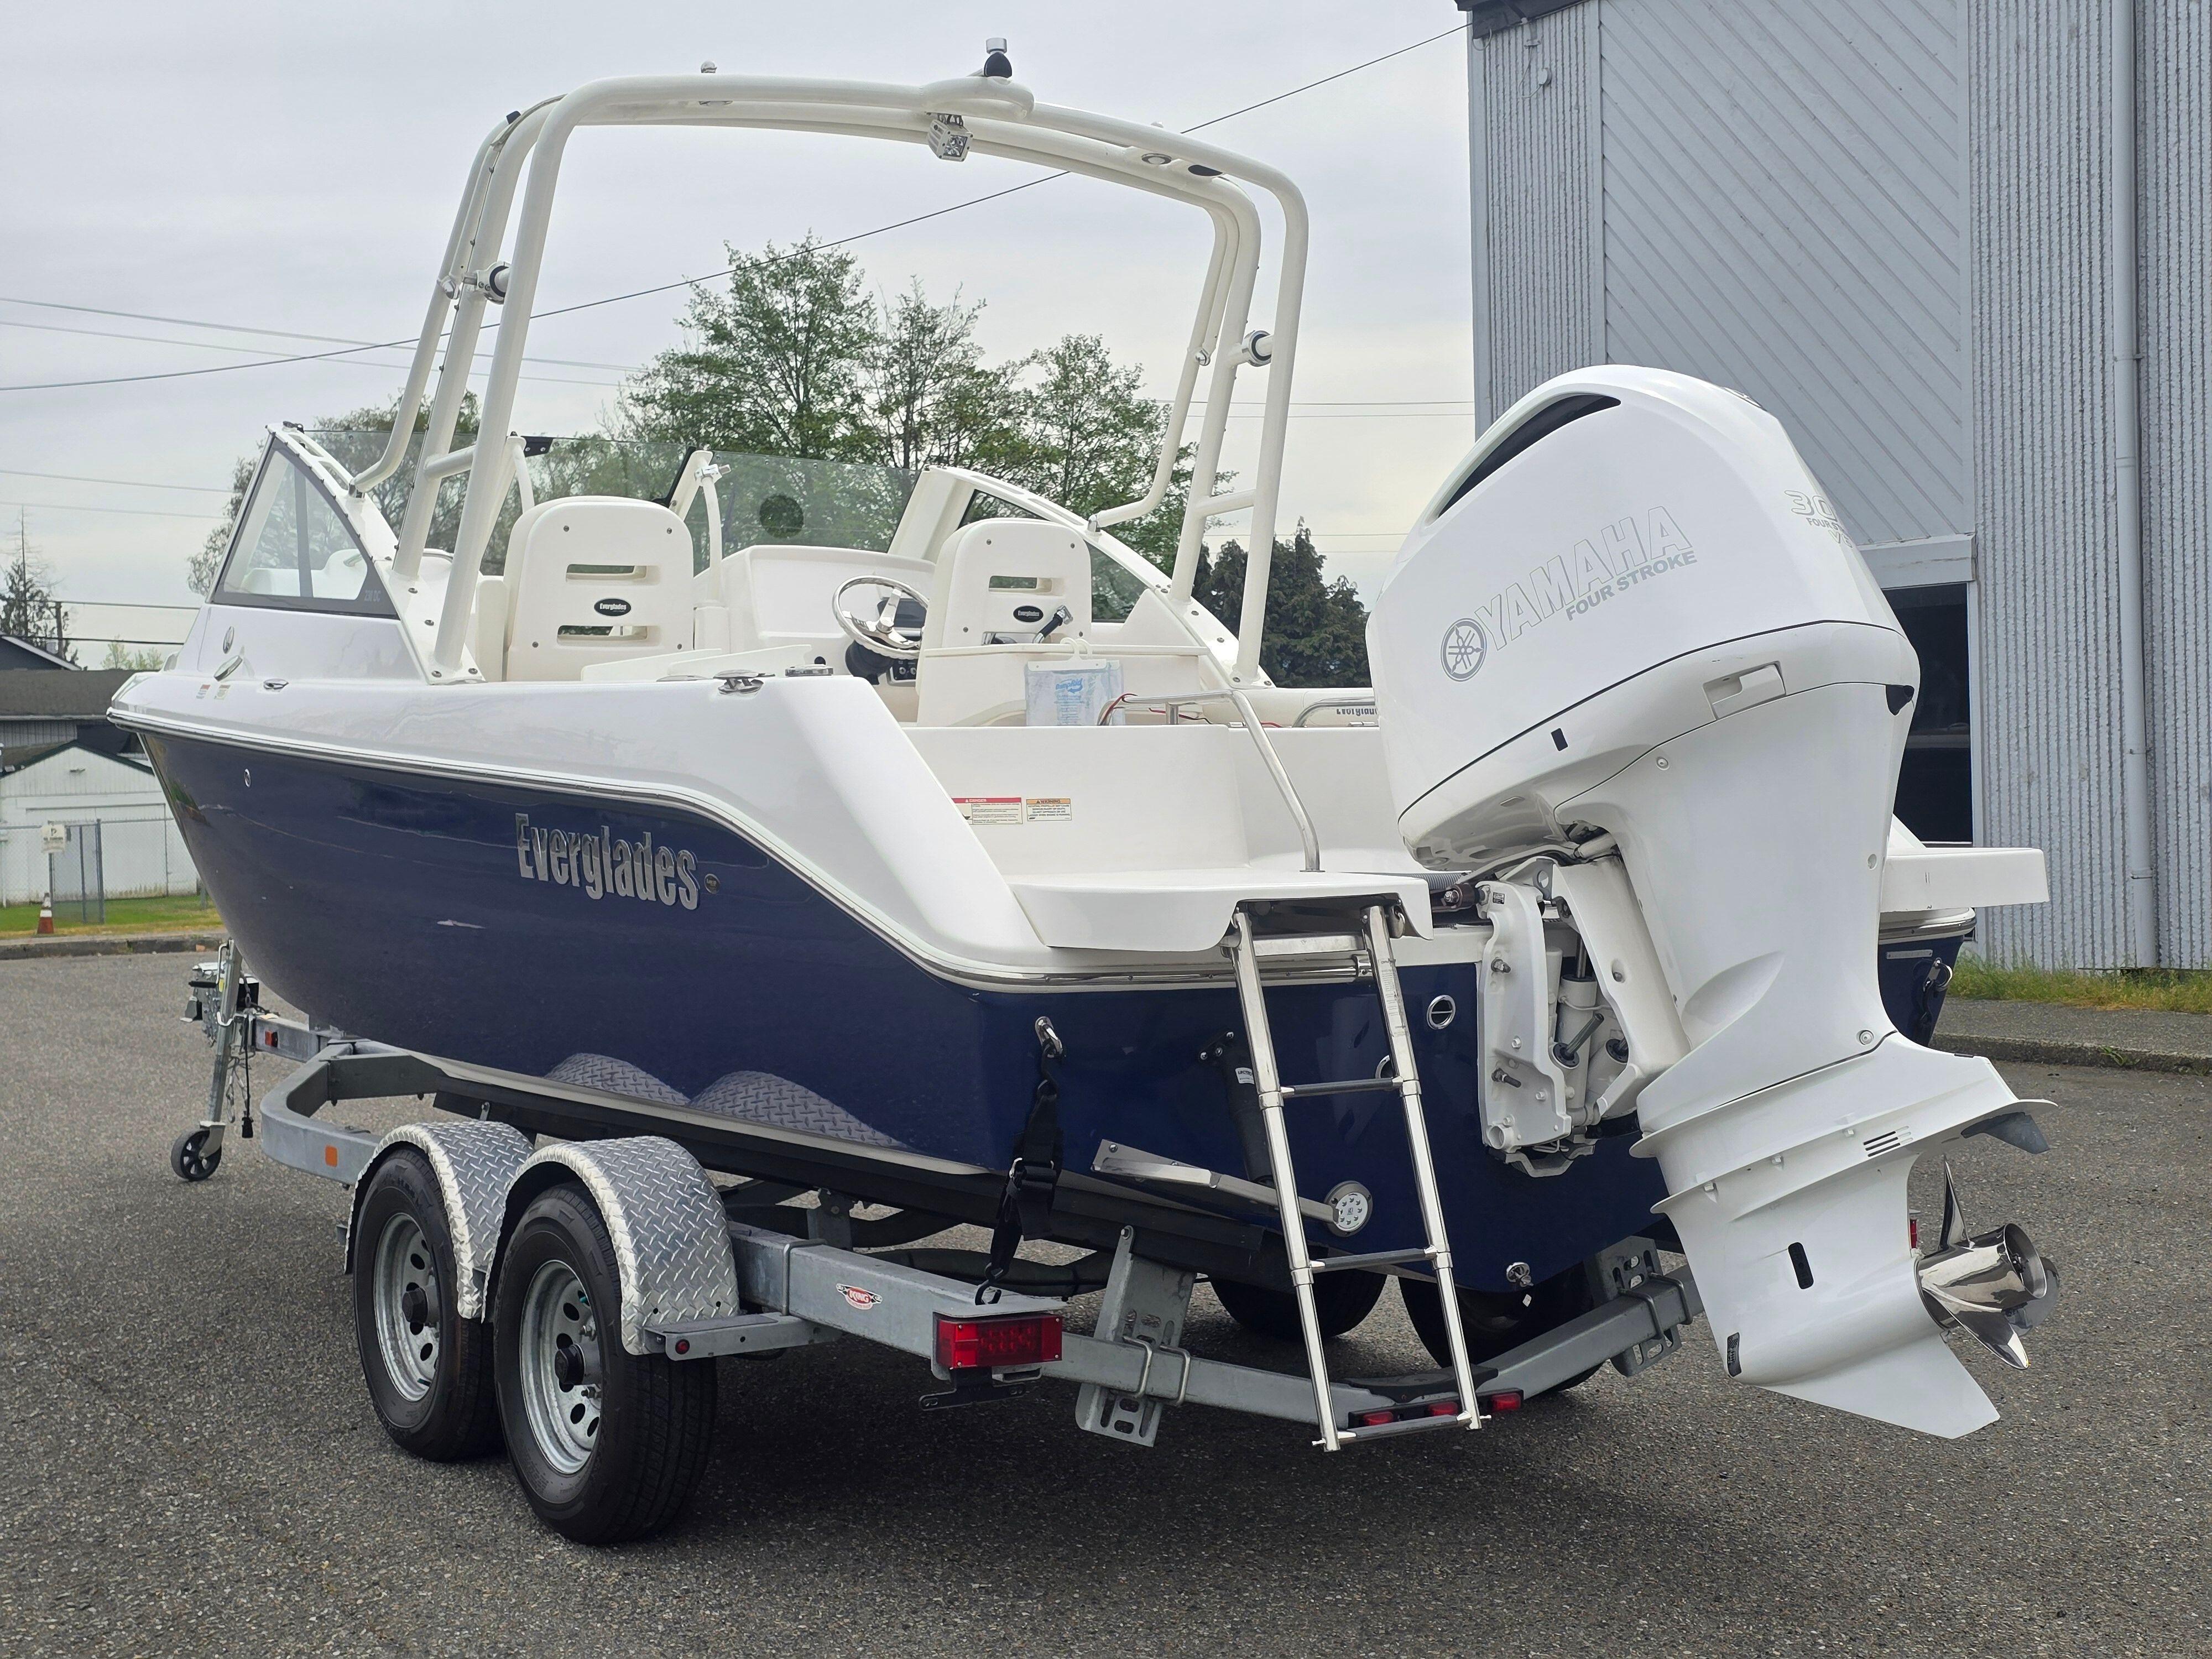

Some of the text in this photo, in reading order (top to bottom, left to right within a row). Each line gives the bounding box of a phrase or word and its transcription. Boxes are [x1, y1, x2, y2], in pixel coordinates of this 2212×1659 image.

[1806, 517, 1833, 529] FOUR
[1474, 505, 1693, 651] YAMAHA
[1566, 550, 1698, 622] FOUR STROKE
[515, 812, 700, 910] Everglades
[849, 1290, 869, 1303] KING
